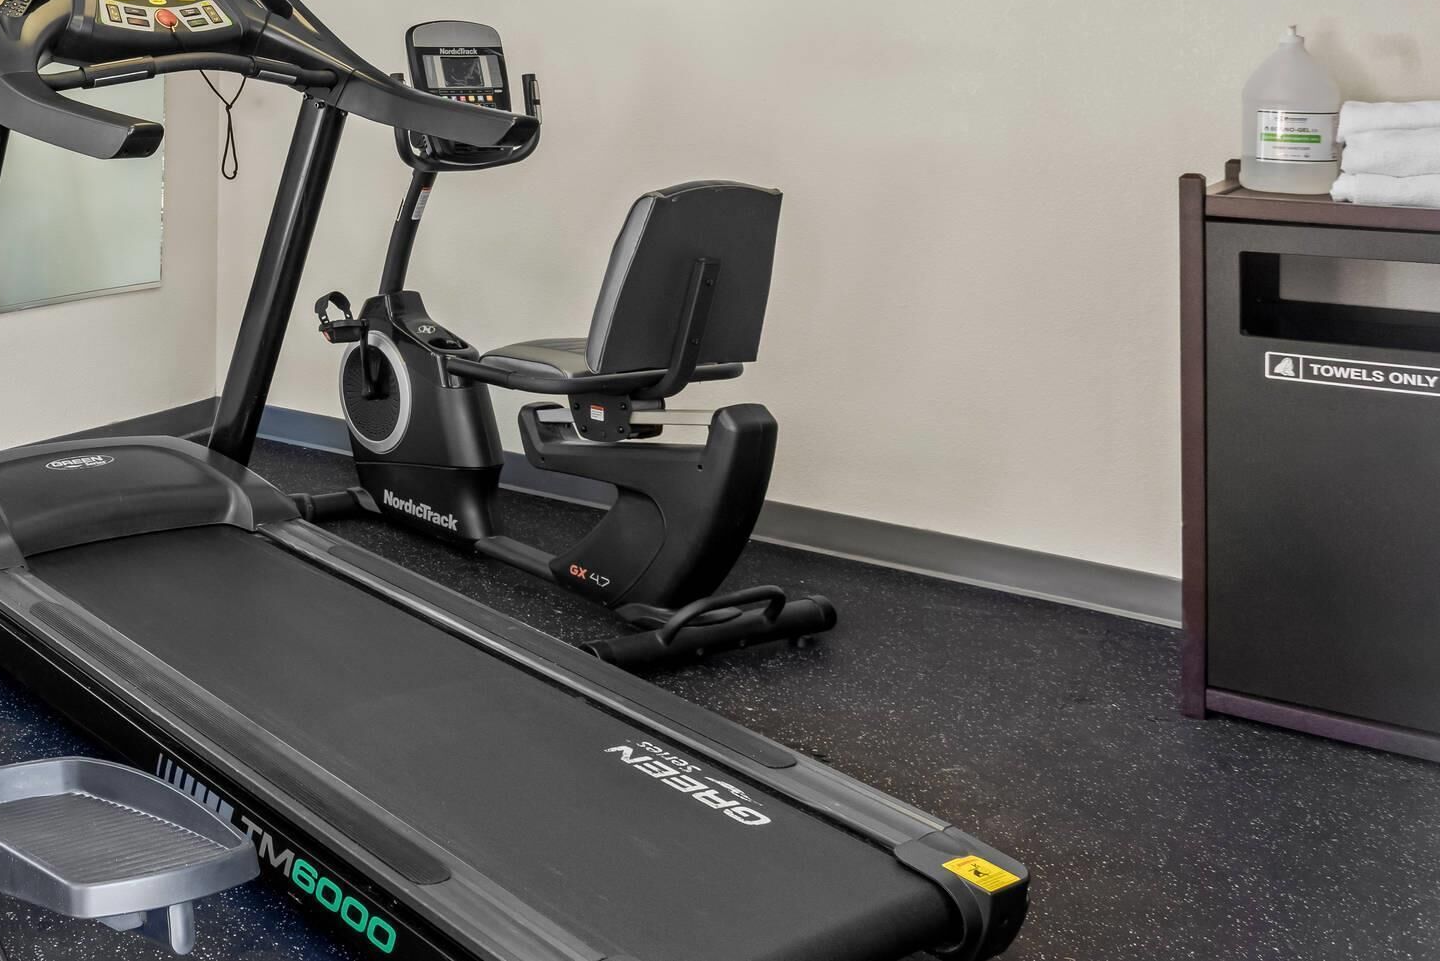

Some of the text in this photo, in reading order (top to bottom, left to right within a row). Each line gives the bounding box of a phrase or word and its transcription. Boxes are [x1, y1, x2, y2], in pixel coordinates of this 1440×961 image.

[440, 47, 478, 55] NordicTrack
[1309, 363, 1439, 388] TOWELS ONLY
[383, 488, 459, 532] NordicTrack
[569, 564, 587, 580] GX
[635, 741, 702, 773] Series
[603, 745, 772, 825] GREEN
[240, 815, 397, 954] TM6000
